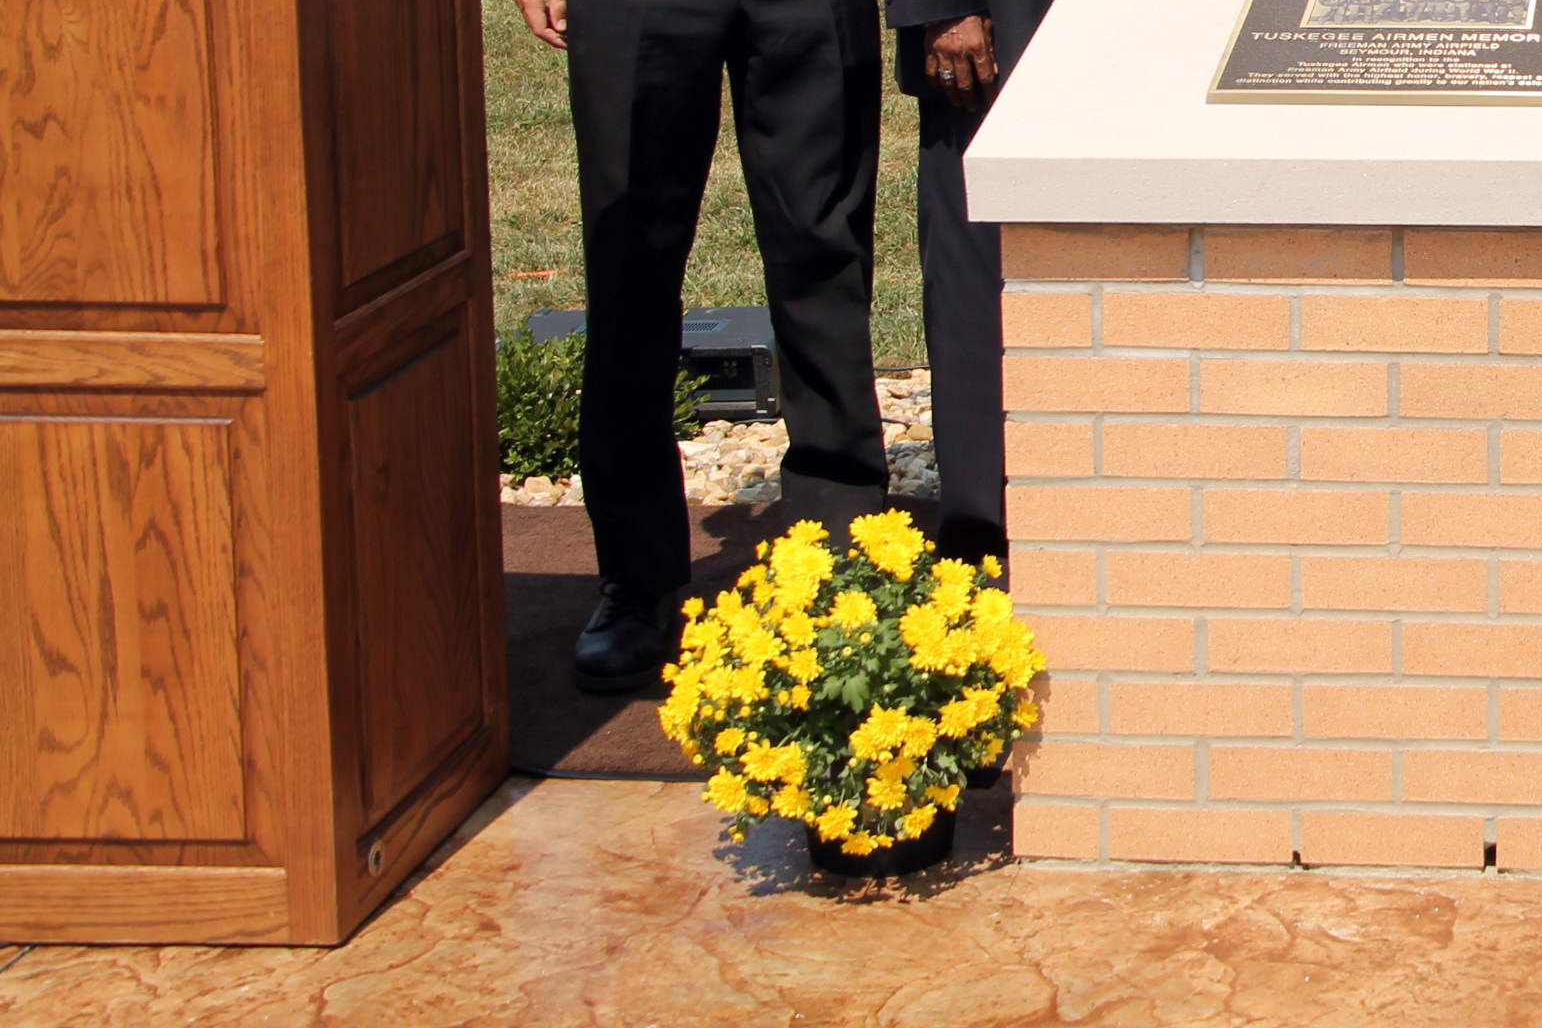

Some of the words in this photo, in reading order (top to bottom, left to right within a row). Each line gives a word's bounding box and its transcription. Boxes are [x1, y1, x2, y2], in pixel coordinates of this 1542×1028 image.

[1251, 32, 1365, 41] TUSKEGEE
[1371, 32, 1454, 42] AIRMEN
[1436, 42, 1500, 50] AIRFIELD
[1339, 48, 1414, 56] SEYMOUR,
